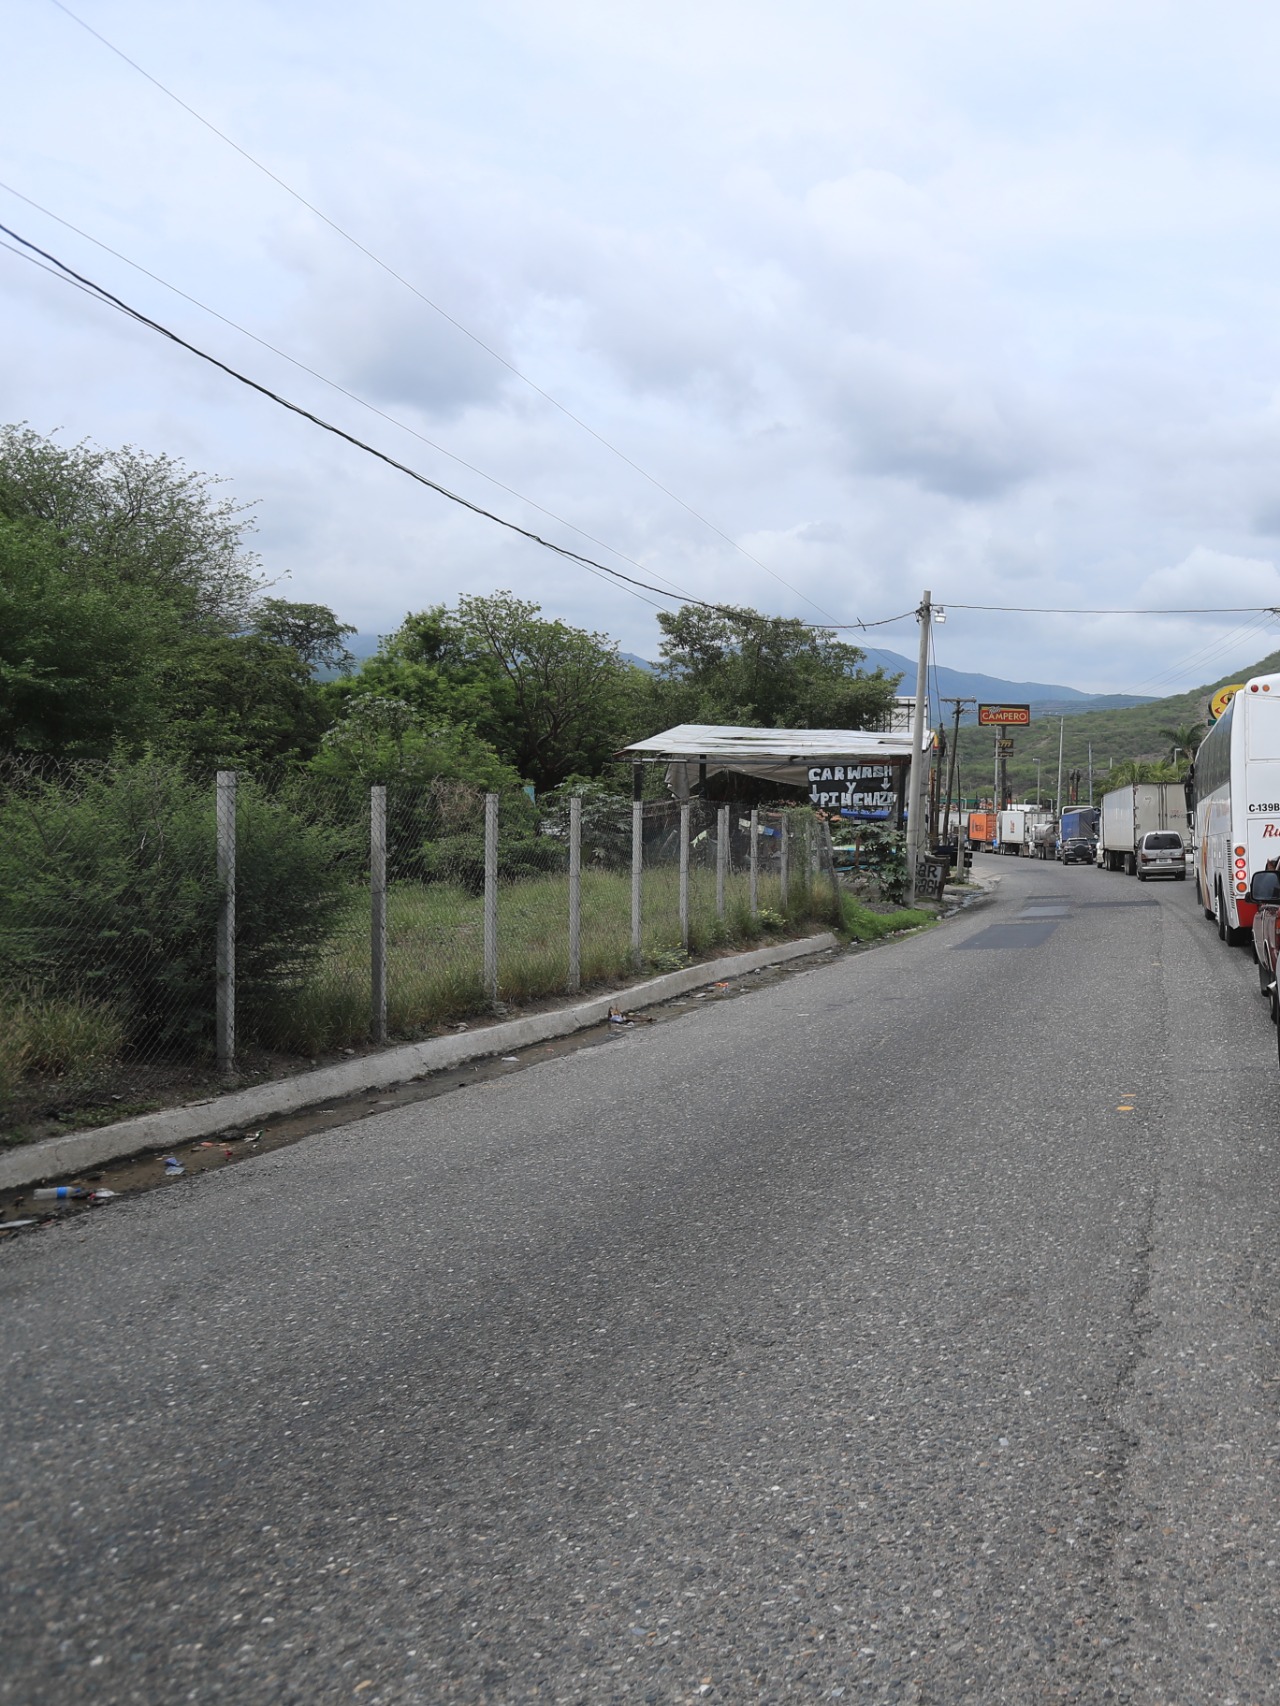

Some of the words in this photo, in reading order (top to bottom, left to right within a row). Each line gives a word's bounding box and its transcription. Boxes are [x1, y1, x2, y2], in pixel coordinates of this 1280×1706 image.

[982, 712, 1027, 721] CAMPERO
[808, 766, 845, 782] CAR
[845, 781, 857, 794] Y
